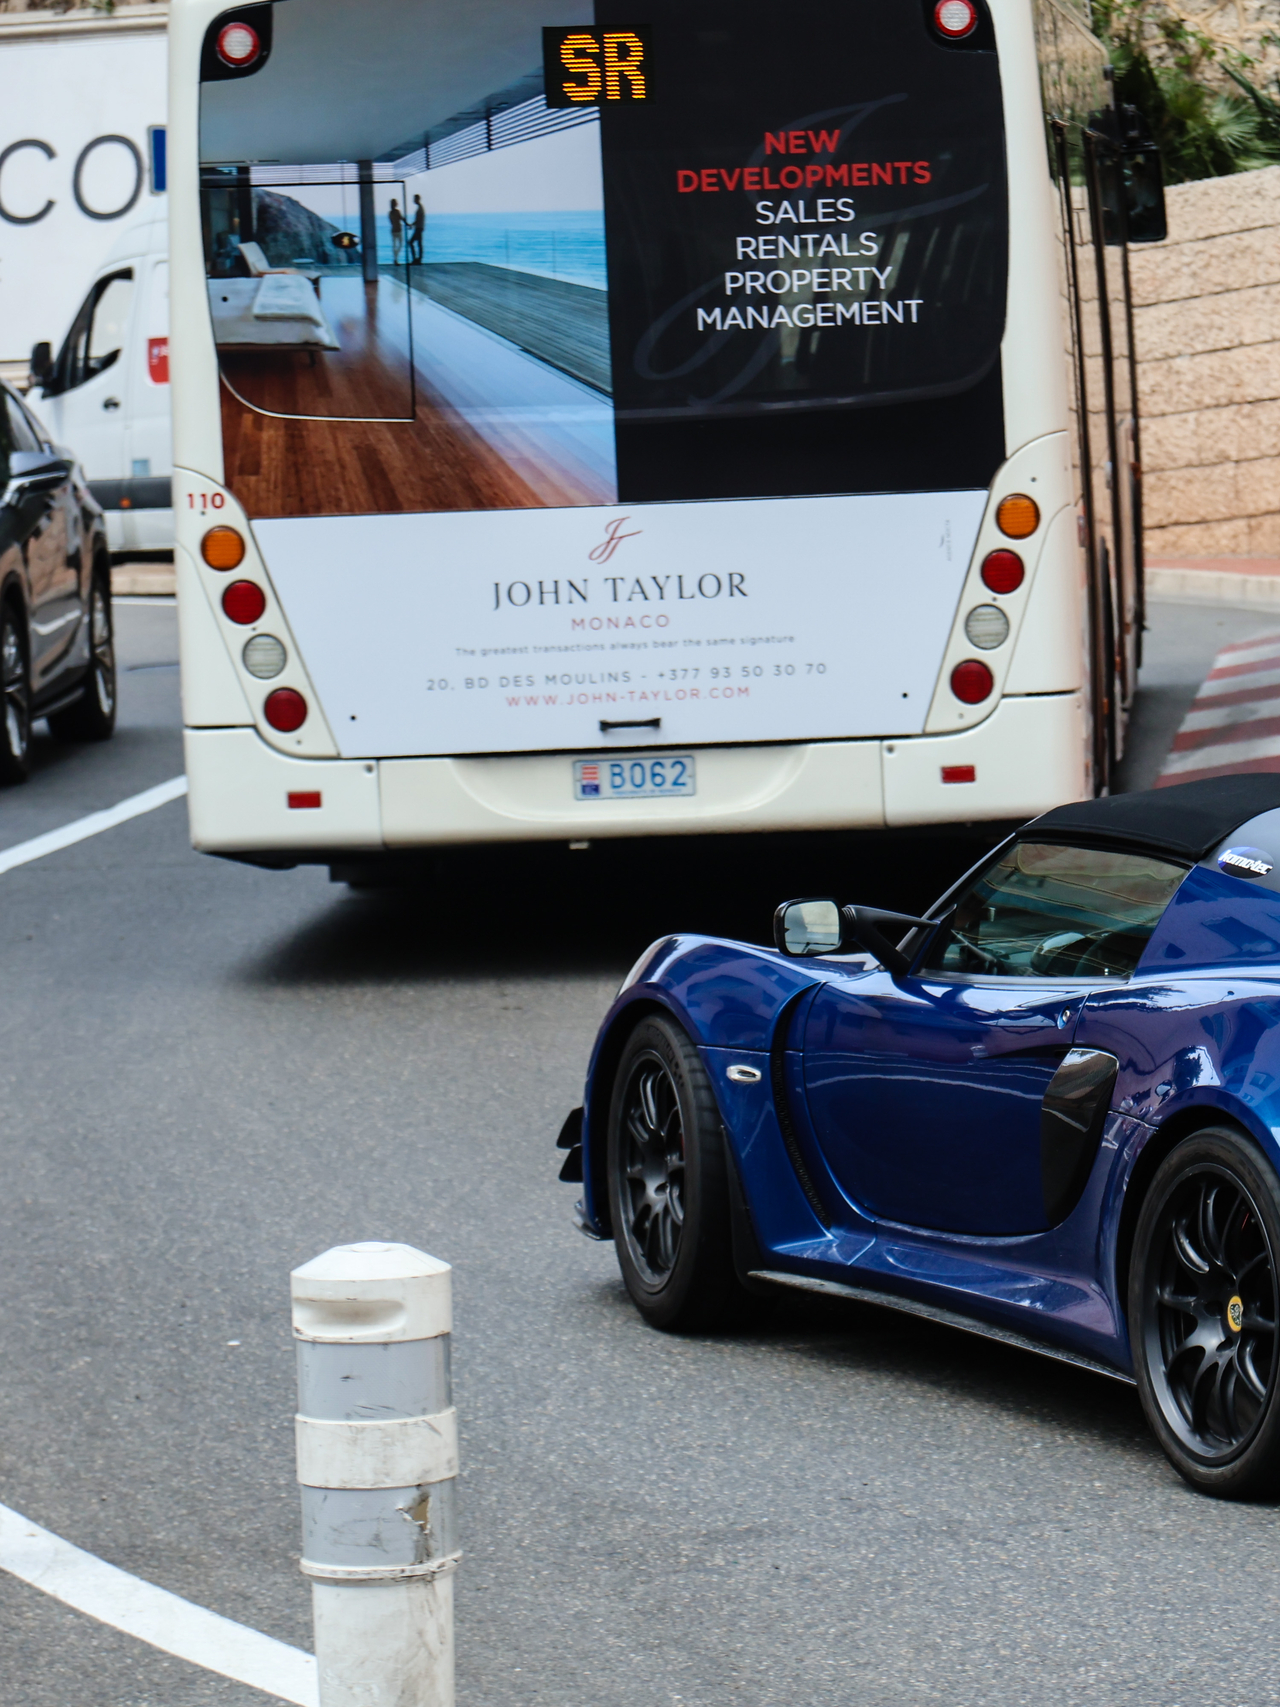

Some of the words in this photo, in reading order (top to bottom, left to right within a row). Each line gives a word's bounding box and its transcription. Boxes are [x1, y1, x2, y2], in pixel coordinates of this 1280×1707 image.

[560, 32, 647, 102] SR
[764, 129, 841, 155] NEW
[677, 161, 932, 193] DEVELOPMENTS
[755, 198, 856, 225] SALES
[736, 231, 879, 261] RENTALS
[724, 265, 893, 296] PROPERTY
[696, 299, 924, 332] MANAGEMENT
[187, 492, 225, 510] 110
[493, 578, 589, 611] JOHN
[603, 572, 749, 603] TAYLOR
[571, 614, 670, 631] MONACO
[455, 647, 476, 657] The
[481, 646, 529, 657] greatest
[533, 642, 605, 654] transactions
[609, 640, 648, 652] always
[652, 638, 678, 649] bear
[683, 637, 702, 648] the
[706, 637, 736, 647] same
[740, 634, 795, 646] signature
[464, 677, 489, 690] BD
[499, 674, 536, 689] DES
[545, 670, 632, 687] MOULINS
[657, 667, 701, 682] +377
[710, 666, 732, 680] 93
[741, 664, 764, 678] 50
[772, 663, 796, 677] 30
[805, 662, 828, 676] 70
[505, 686, 750, 706] WWW.JOHN-TAYLOR.COM
[609, 761, 688, 789] B062
